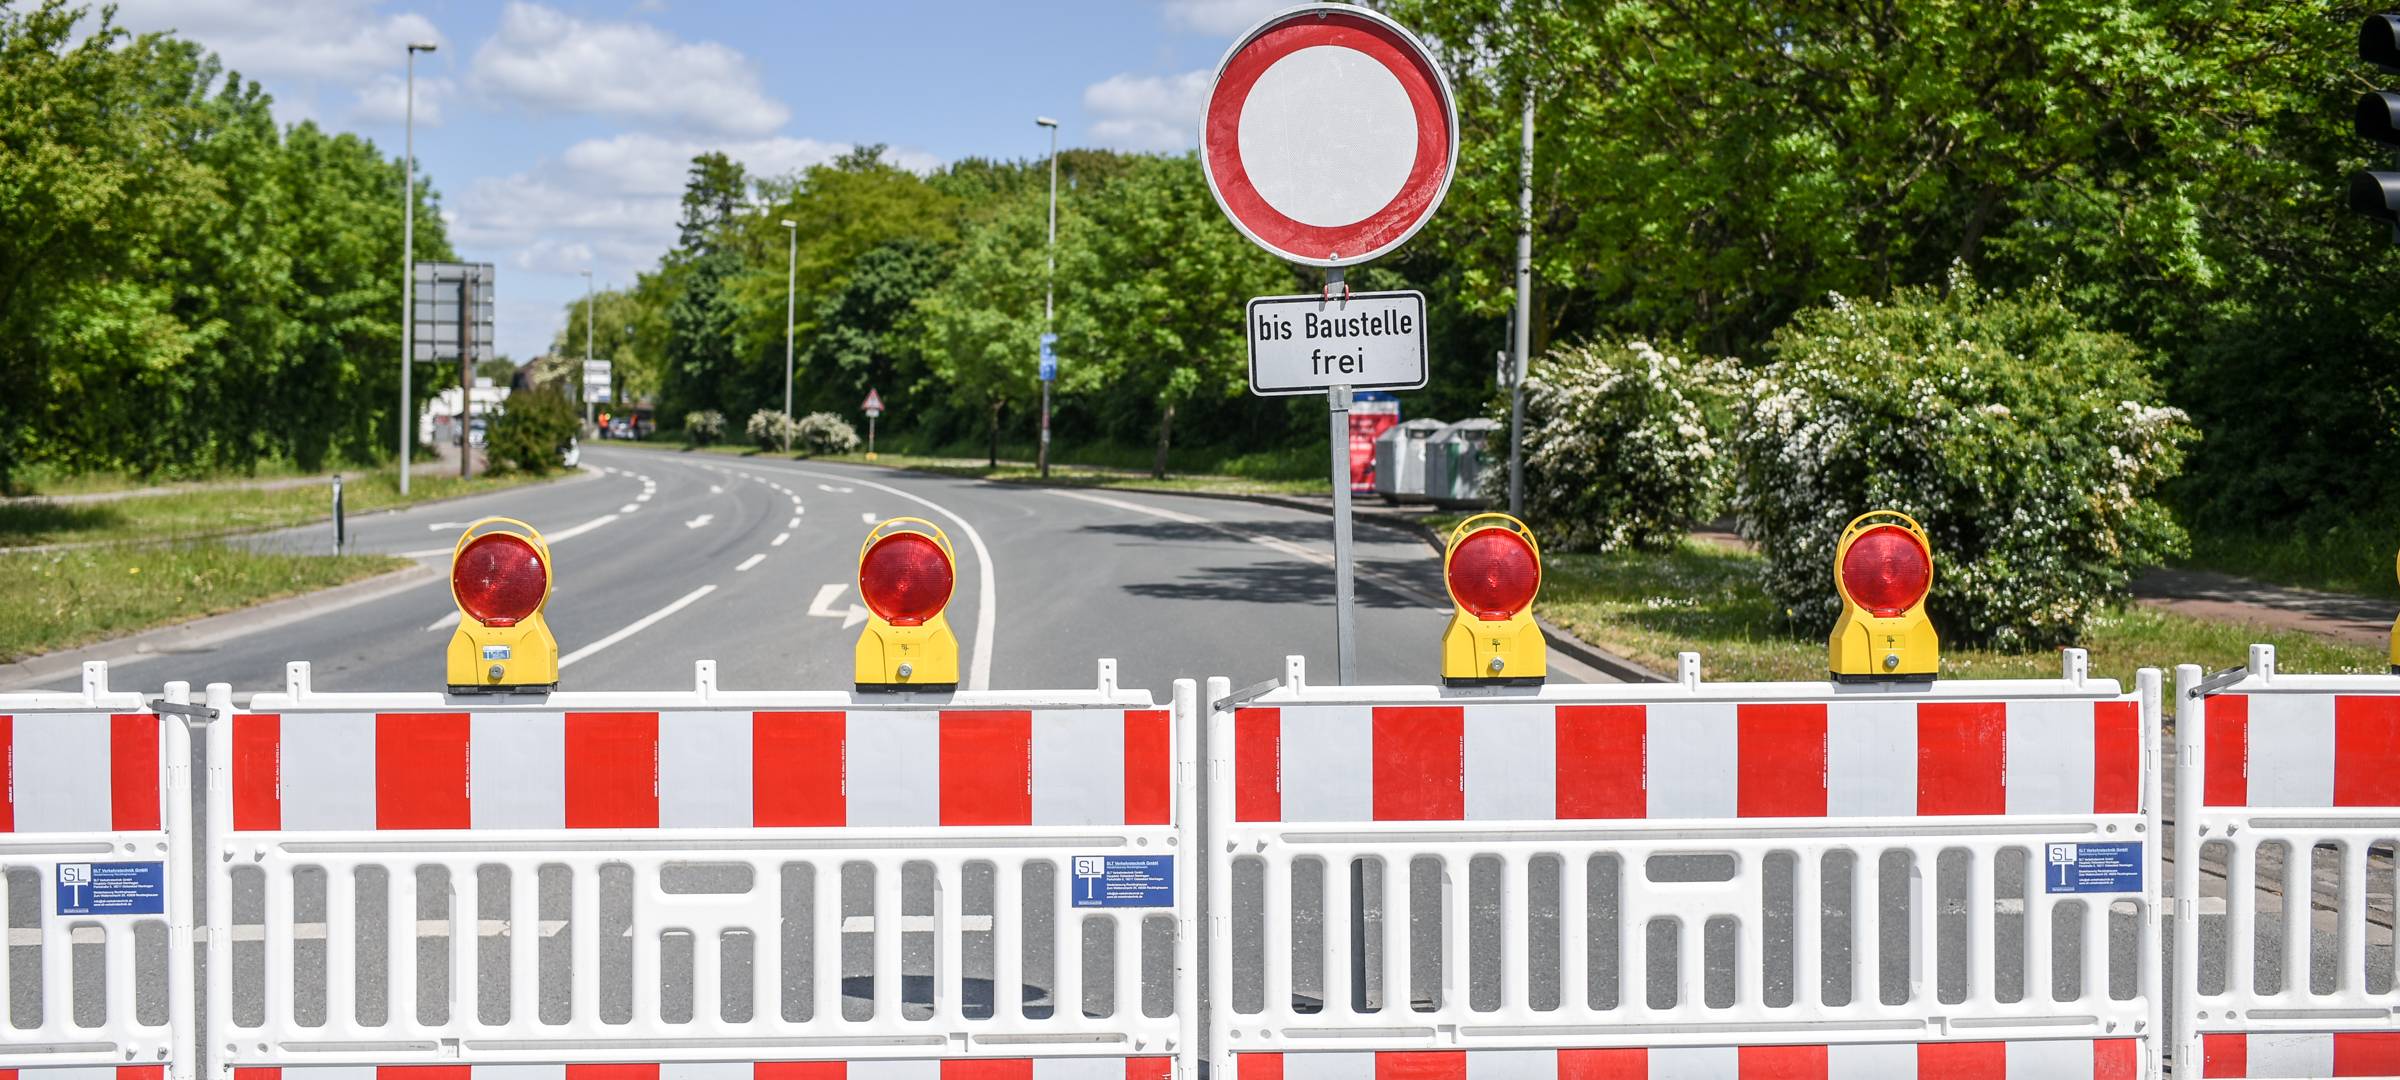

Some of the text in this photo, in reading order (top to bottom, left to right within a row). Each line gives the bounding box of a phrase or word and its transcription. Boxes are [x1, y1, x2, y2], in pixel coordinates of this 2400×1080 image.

[1259, 309, 1412, 341] bis Baustelle
[1311, 347, 1363, 375] frei
